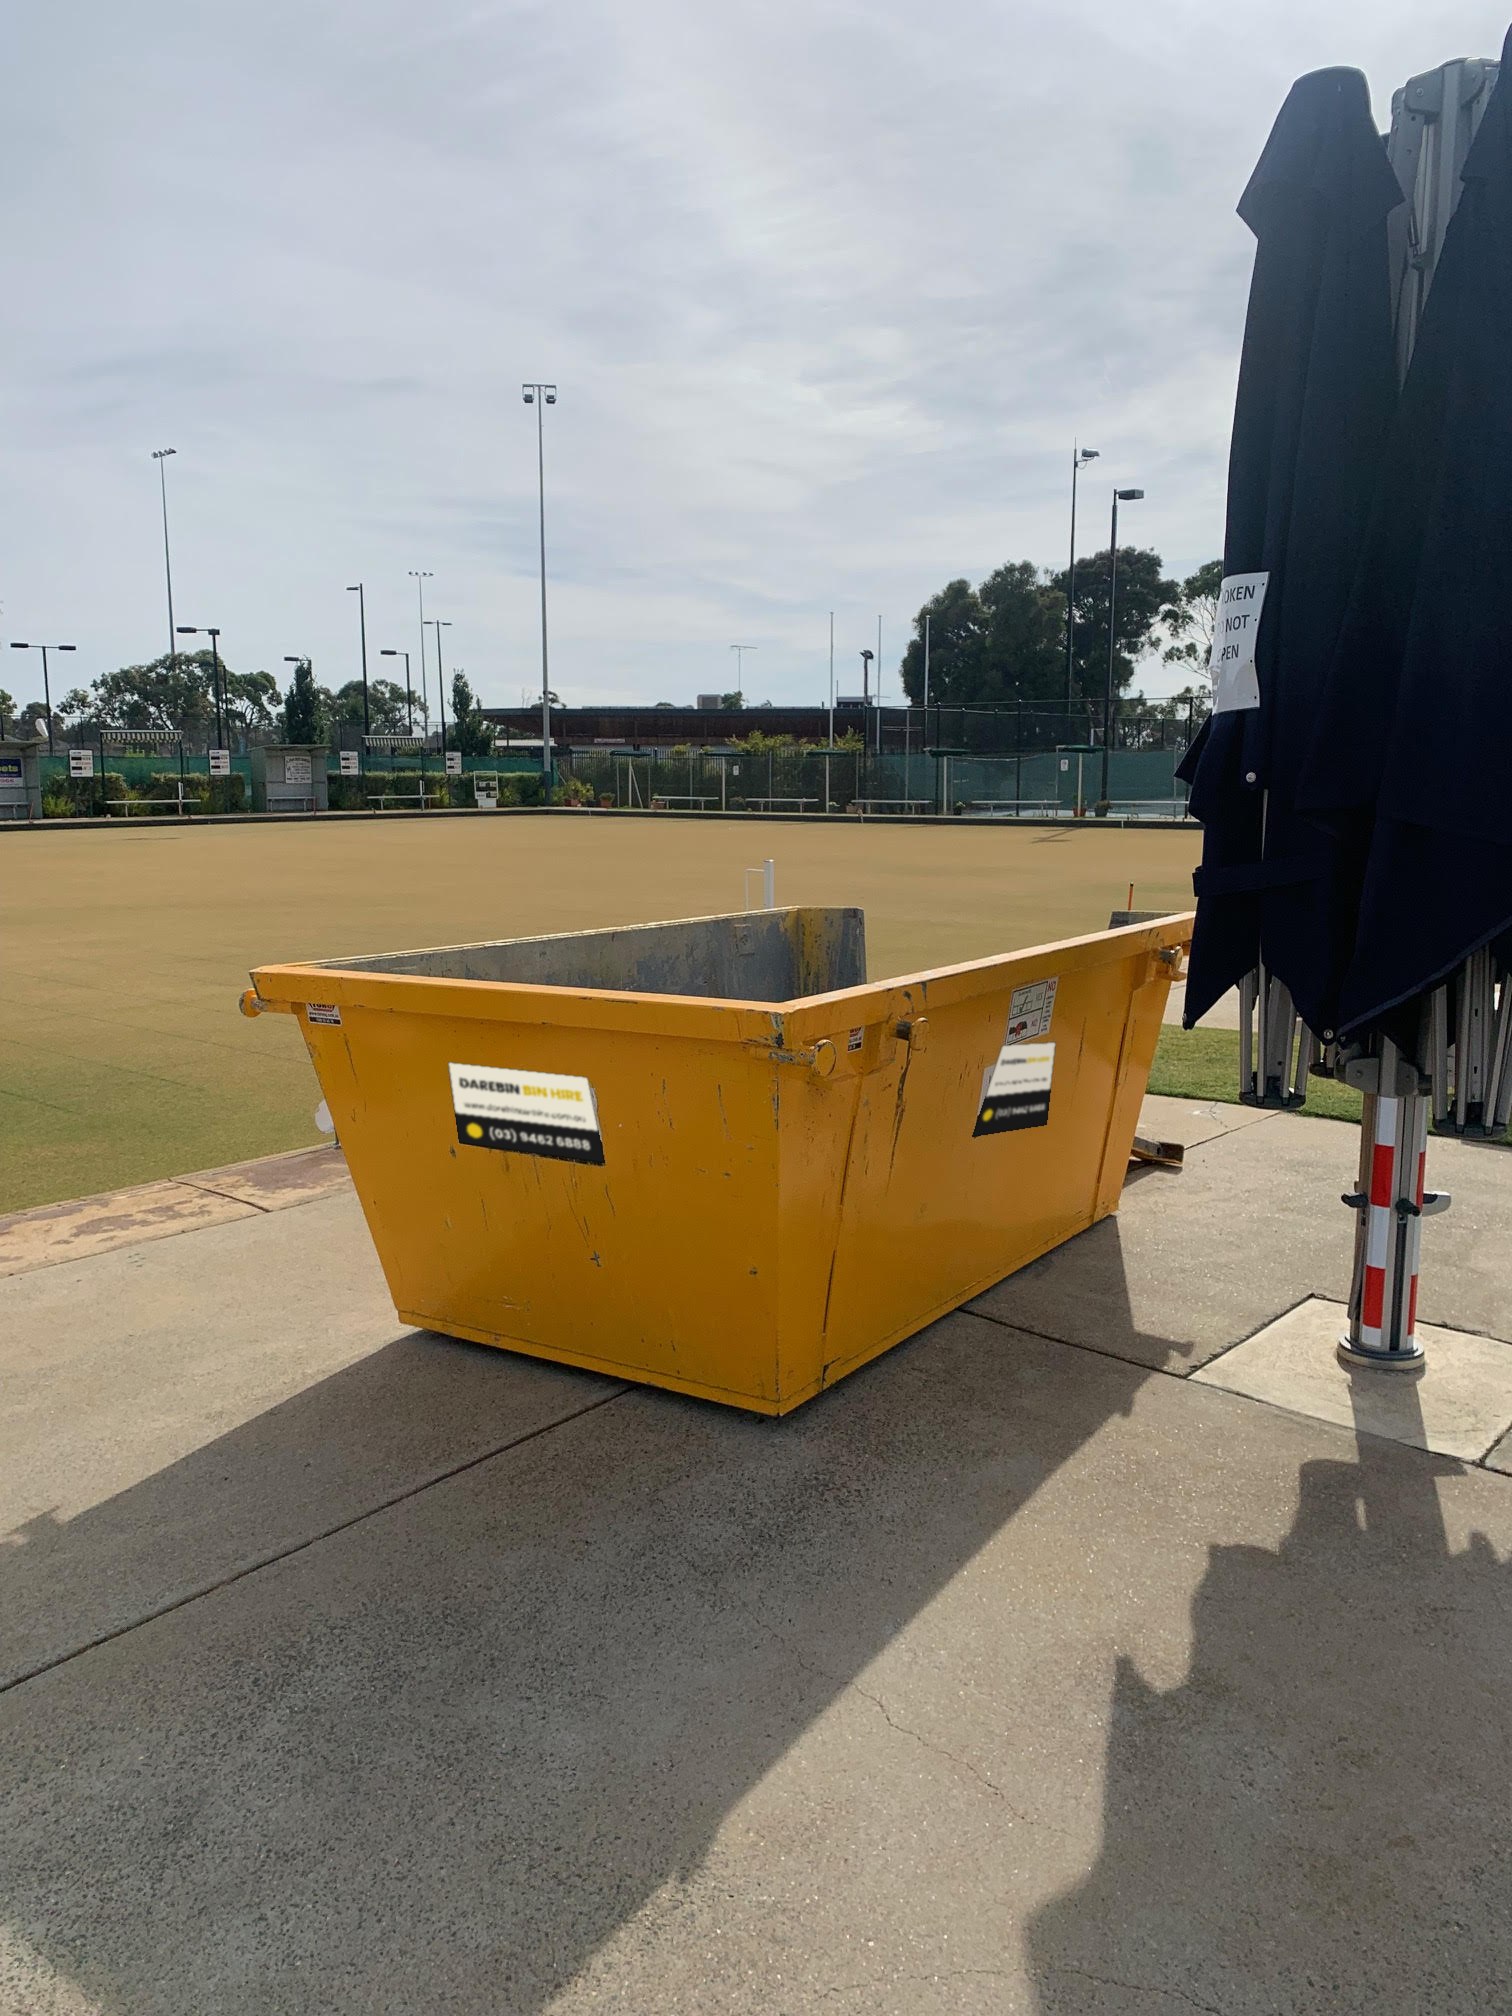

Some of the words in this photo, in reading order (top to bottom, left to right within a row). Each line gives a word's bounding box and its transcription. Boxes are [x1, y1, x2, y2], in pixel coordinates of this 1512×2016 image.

[1223, 585, 1255, 604] OKEN
[1226, 614, 1250, 632] NOT
[459, 1077, 520, 1095] DAREBIN
[522, 1084, 548, 1098] BIN
[551, 1089, 583, 1102] HIRE
[488, 1126, 517, 1144] (03)
[519, 1131, 555, 1146] 9462
